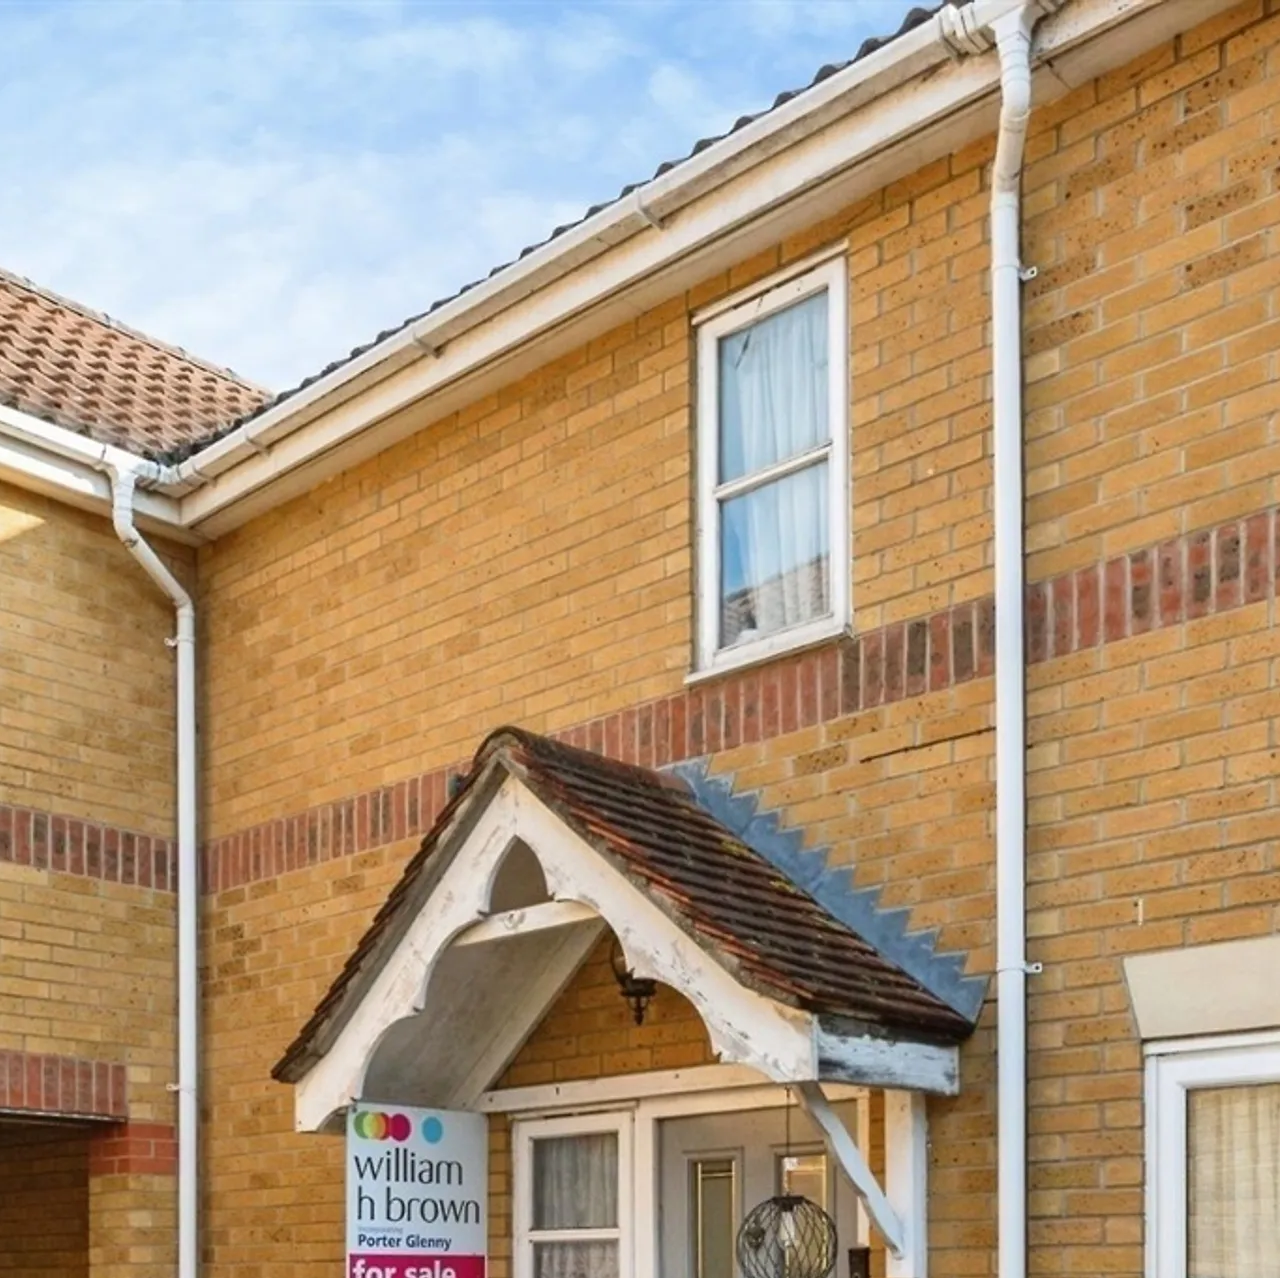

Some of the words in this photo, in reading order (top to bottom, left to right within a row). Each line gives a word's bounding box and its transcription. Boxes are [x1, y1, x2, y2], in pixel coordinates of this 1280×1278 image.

[353, 1147, 463, 1186] william
[356, 1186, 376, 1222] h
[386, 1187, 480, 1224] brown
[358, 1234, 402, 1248] Porter
[406, 1234, 452, 1252] Glenny
